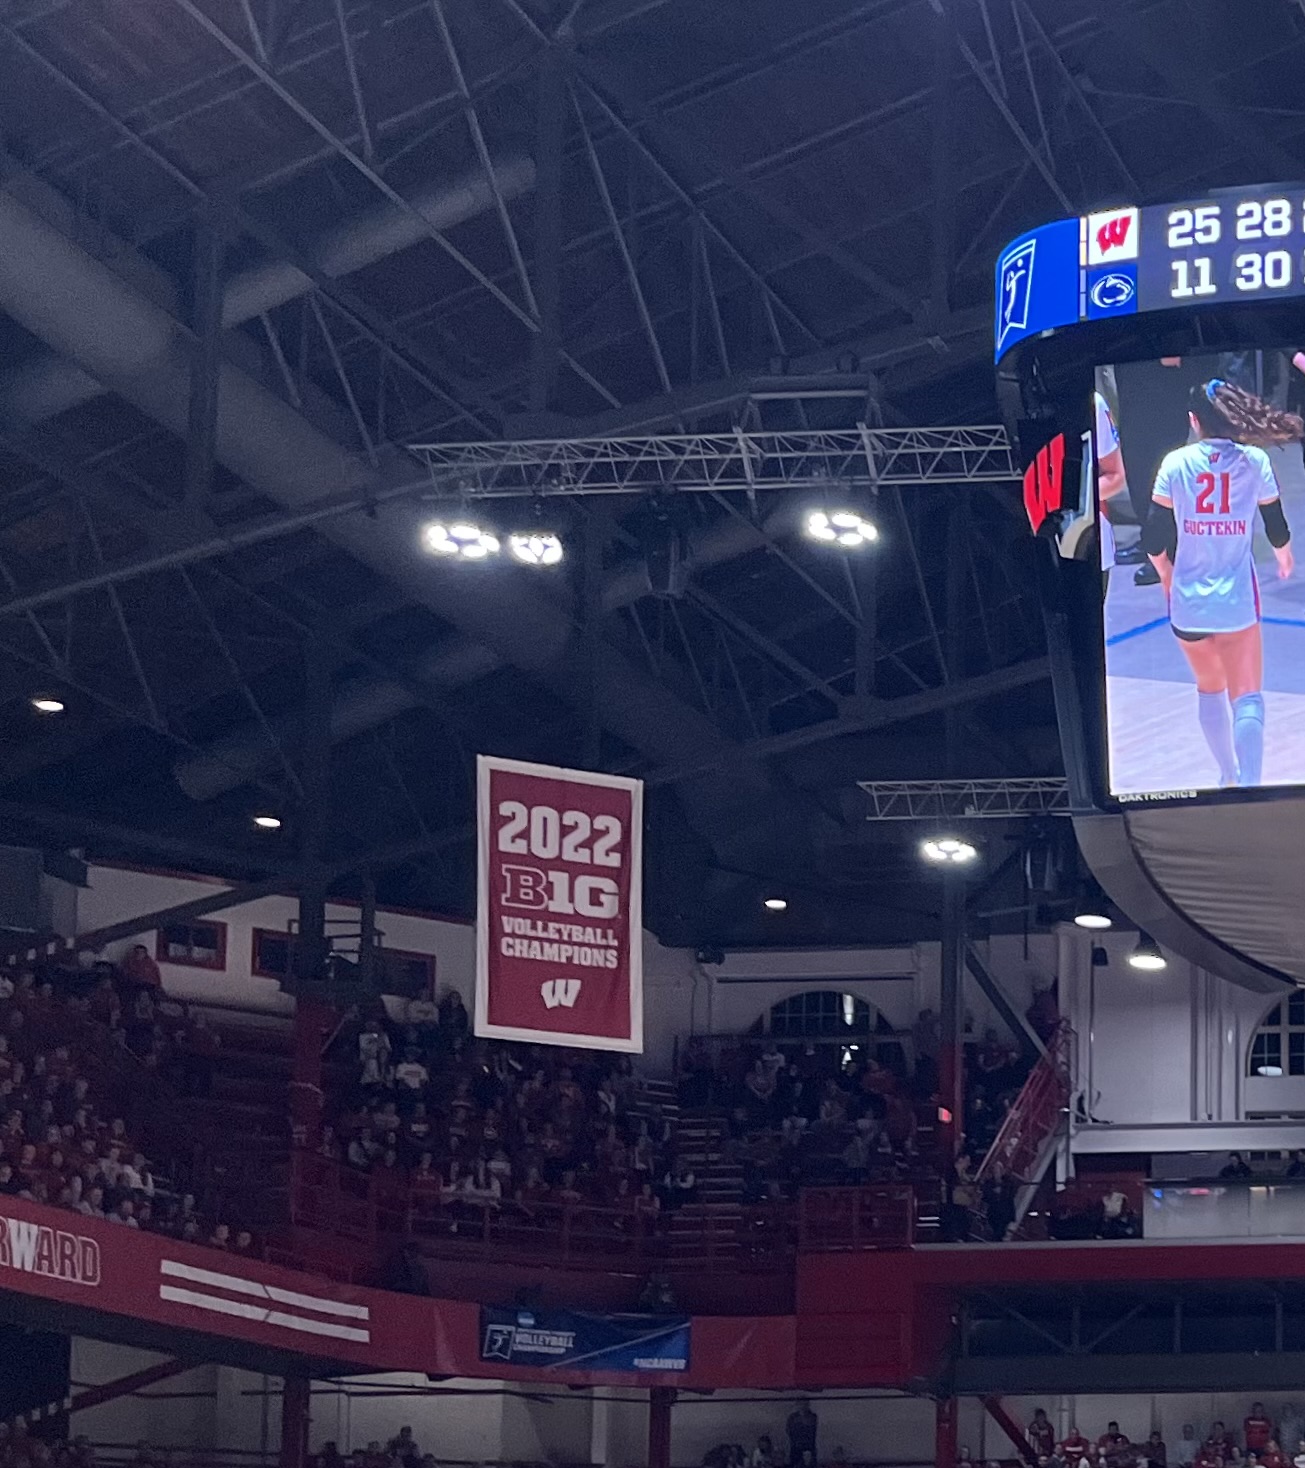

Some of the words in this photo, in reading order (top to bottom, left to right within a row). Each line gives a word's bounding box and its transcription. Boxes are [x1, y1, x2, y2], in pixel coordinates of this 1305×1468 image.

[1168, 206, 1221, 249] 25
[1236, 199, 1291, 240] 28
[1171, 257, 1217, 298] 11
[1236, 251, 1291, 291] 30
[1195, 472, 1231, 514] 21
[1118, 789, 1198, 803] DAKTRONICS
[498, 800, 622, 868] 2022
[501, 915, 618, 947] VOLLEYBALL
[501, 936, 618, 969] CHAMPIONS
